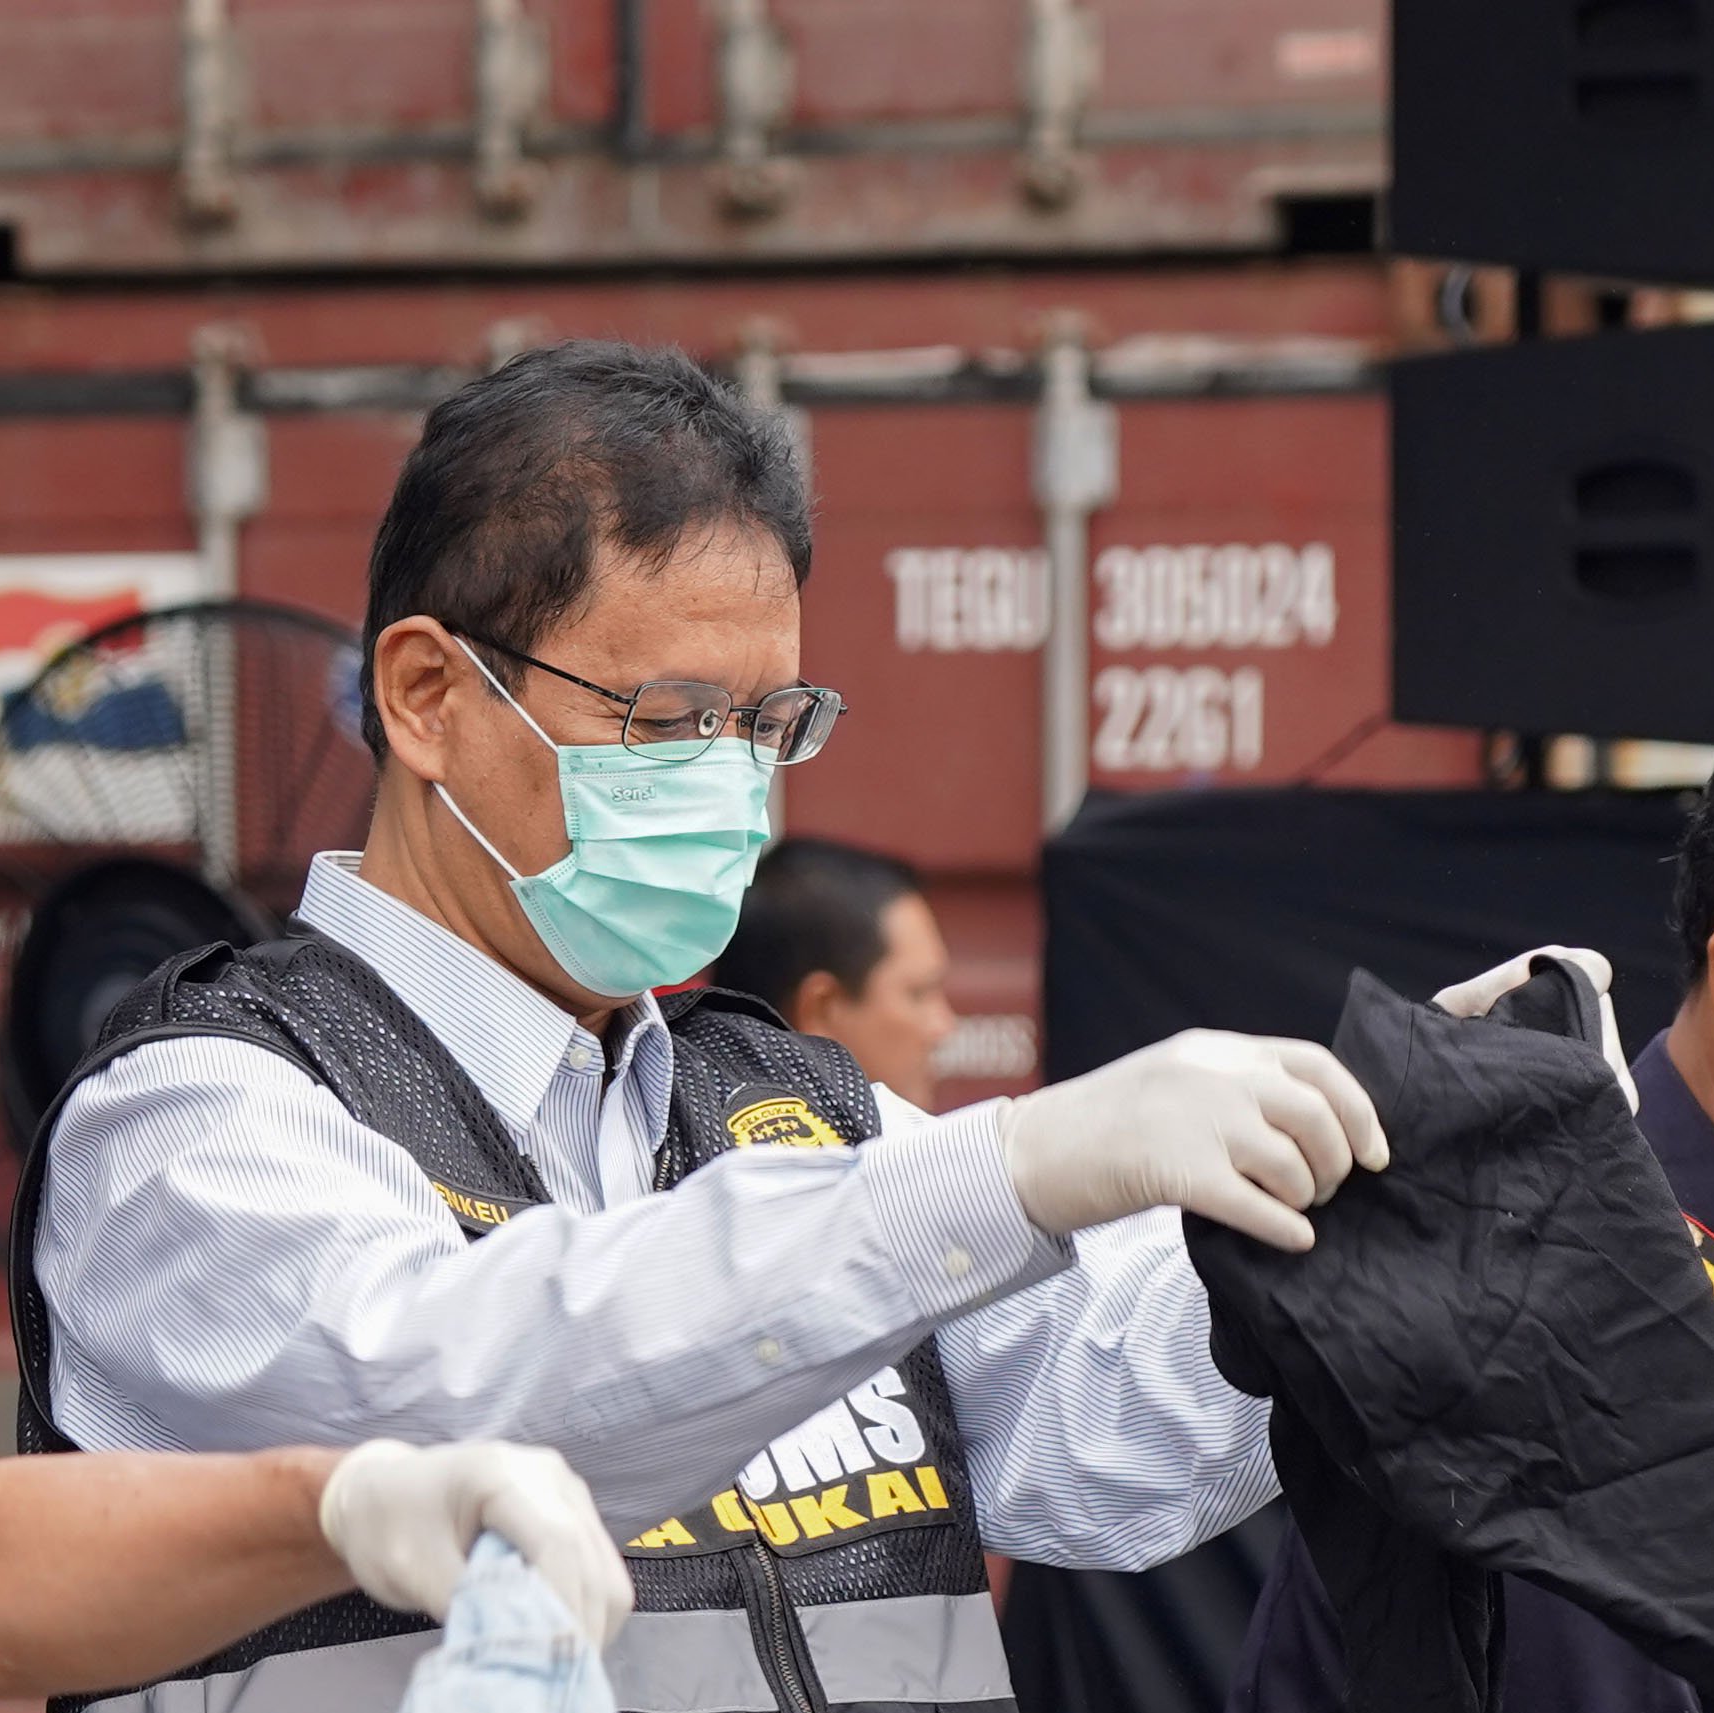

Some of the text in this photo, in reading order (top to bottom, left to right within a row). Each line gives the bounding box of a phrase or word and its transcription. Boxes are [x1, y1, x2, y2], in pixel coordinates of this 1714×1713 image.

[885, 541, 1337, 653] TEGU 305024
[431, 1181, 510, 1225] ENKEU
